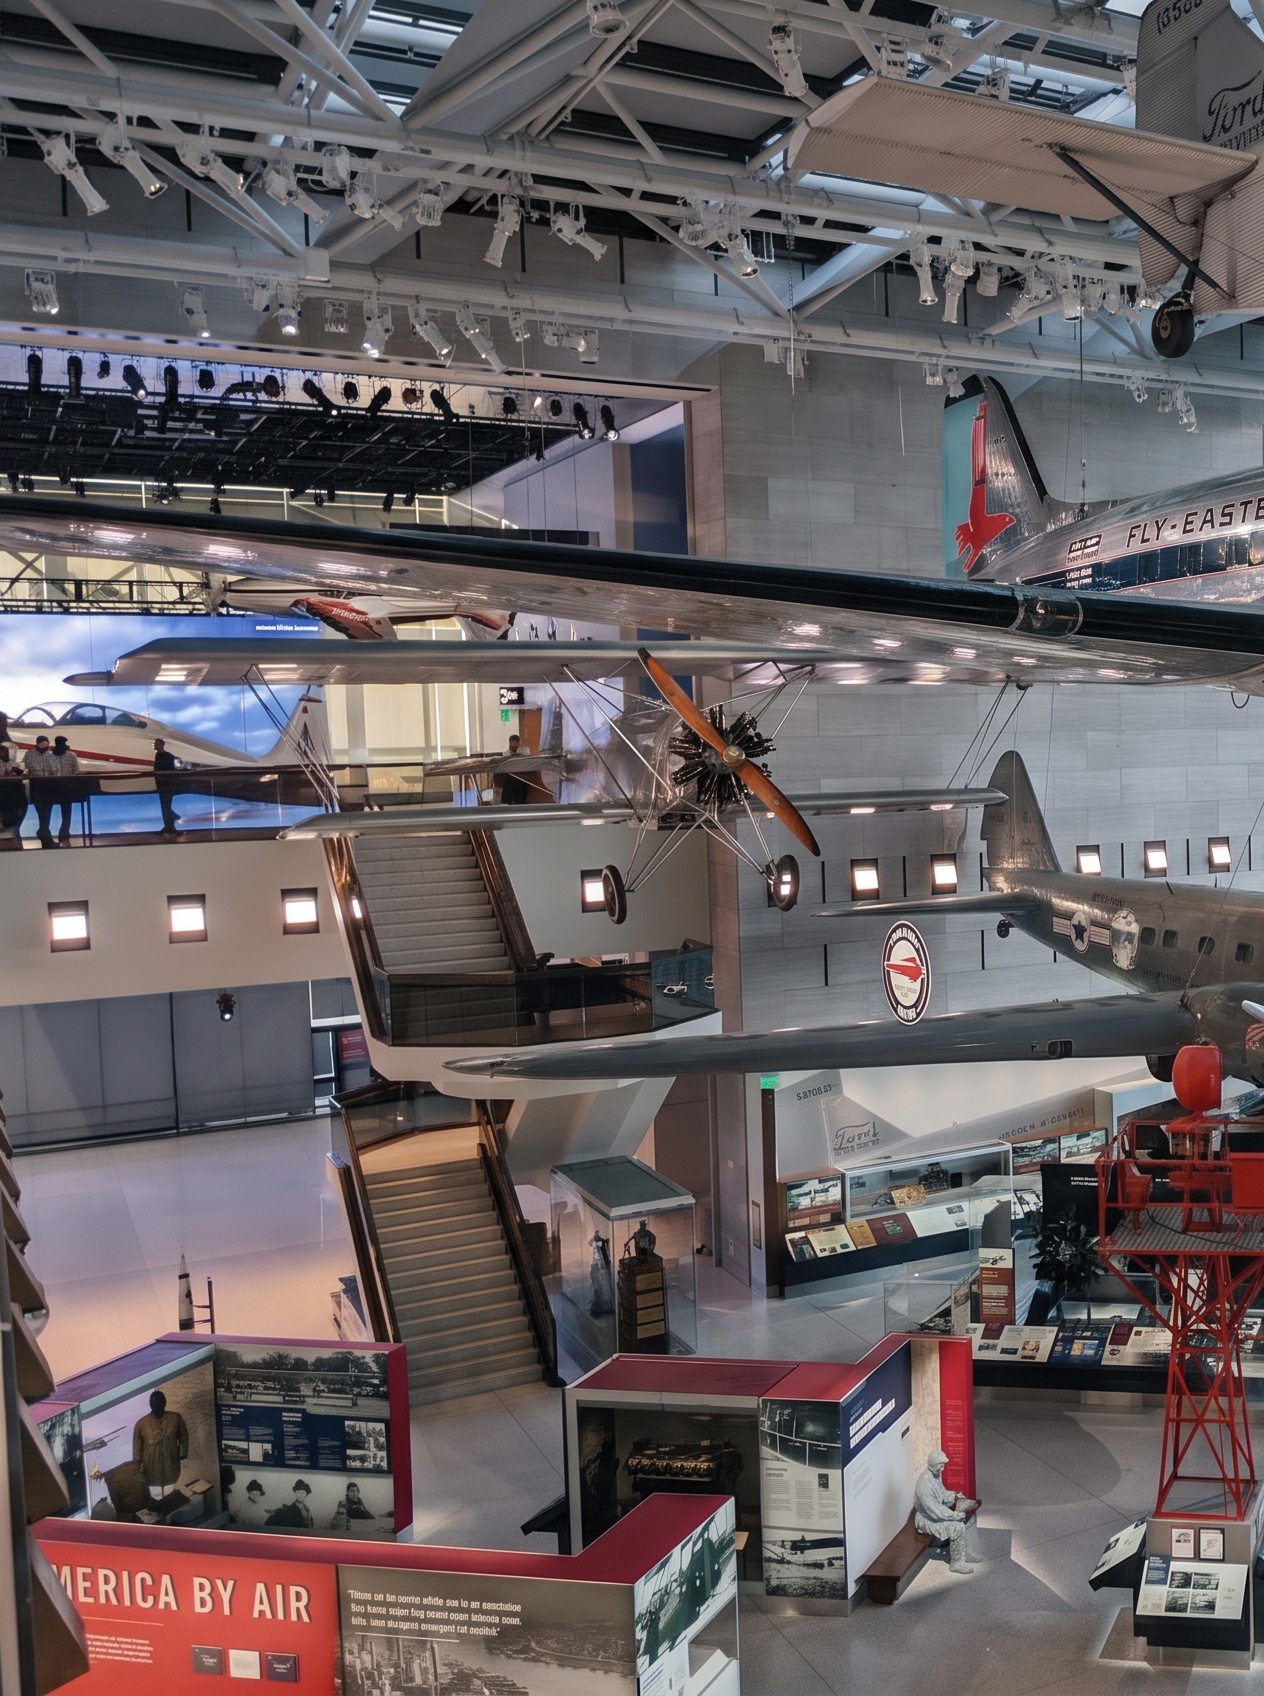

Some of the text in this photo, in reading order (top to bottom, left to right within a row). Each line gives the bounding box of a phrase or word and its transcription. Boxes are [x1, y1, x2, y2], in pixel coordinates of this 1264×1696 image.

[51, 1564, 311, 1623] MERICA BY AIR
